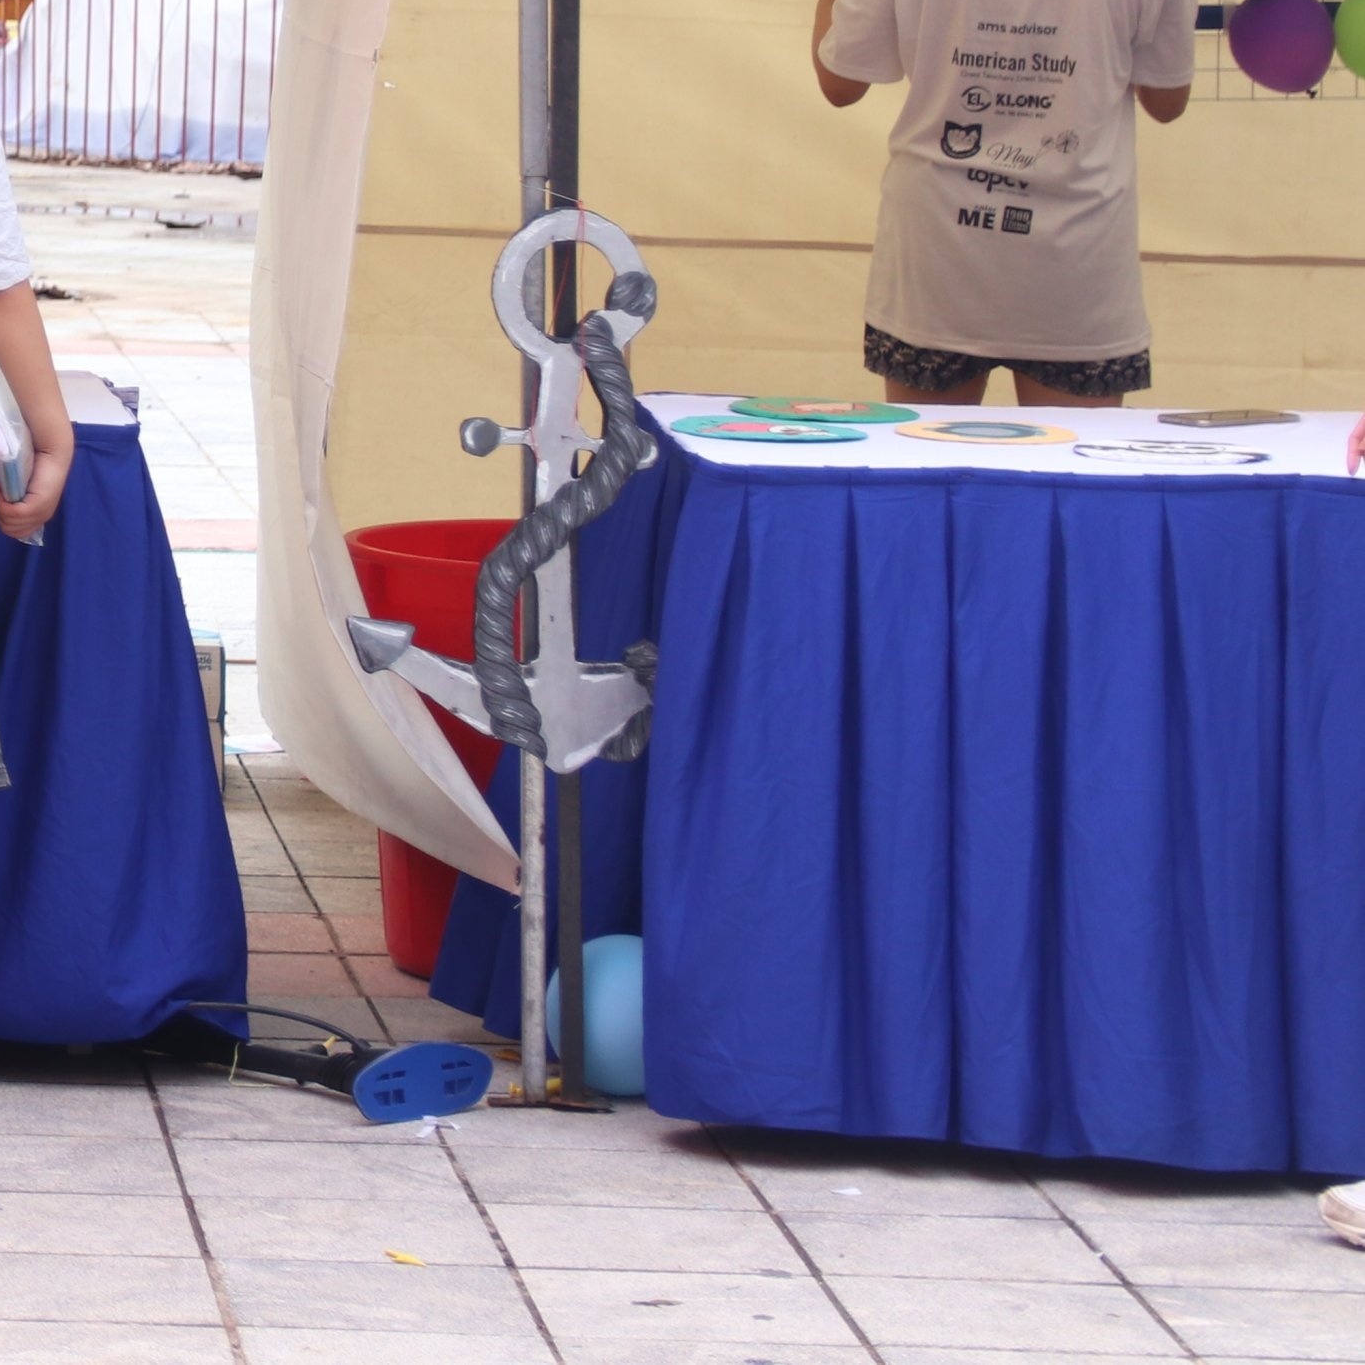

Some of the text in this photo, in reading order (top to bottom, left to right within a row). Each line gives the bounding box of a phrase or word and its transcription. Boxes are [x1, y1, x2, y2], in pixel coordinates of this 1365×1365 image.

[977, 21, 1058, 35] ams advisor
[951, 47, 1077, 77] American Study
[986, 142, 1036, 170] May
[958, 208, 996, 231] ME
